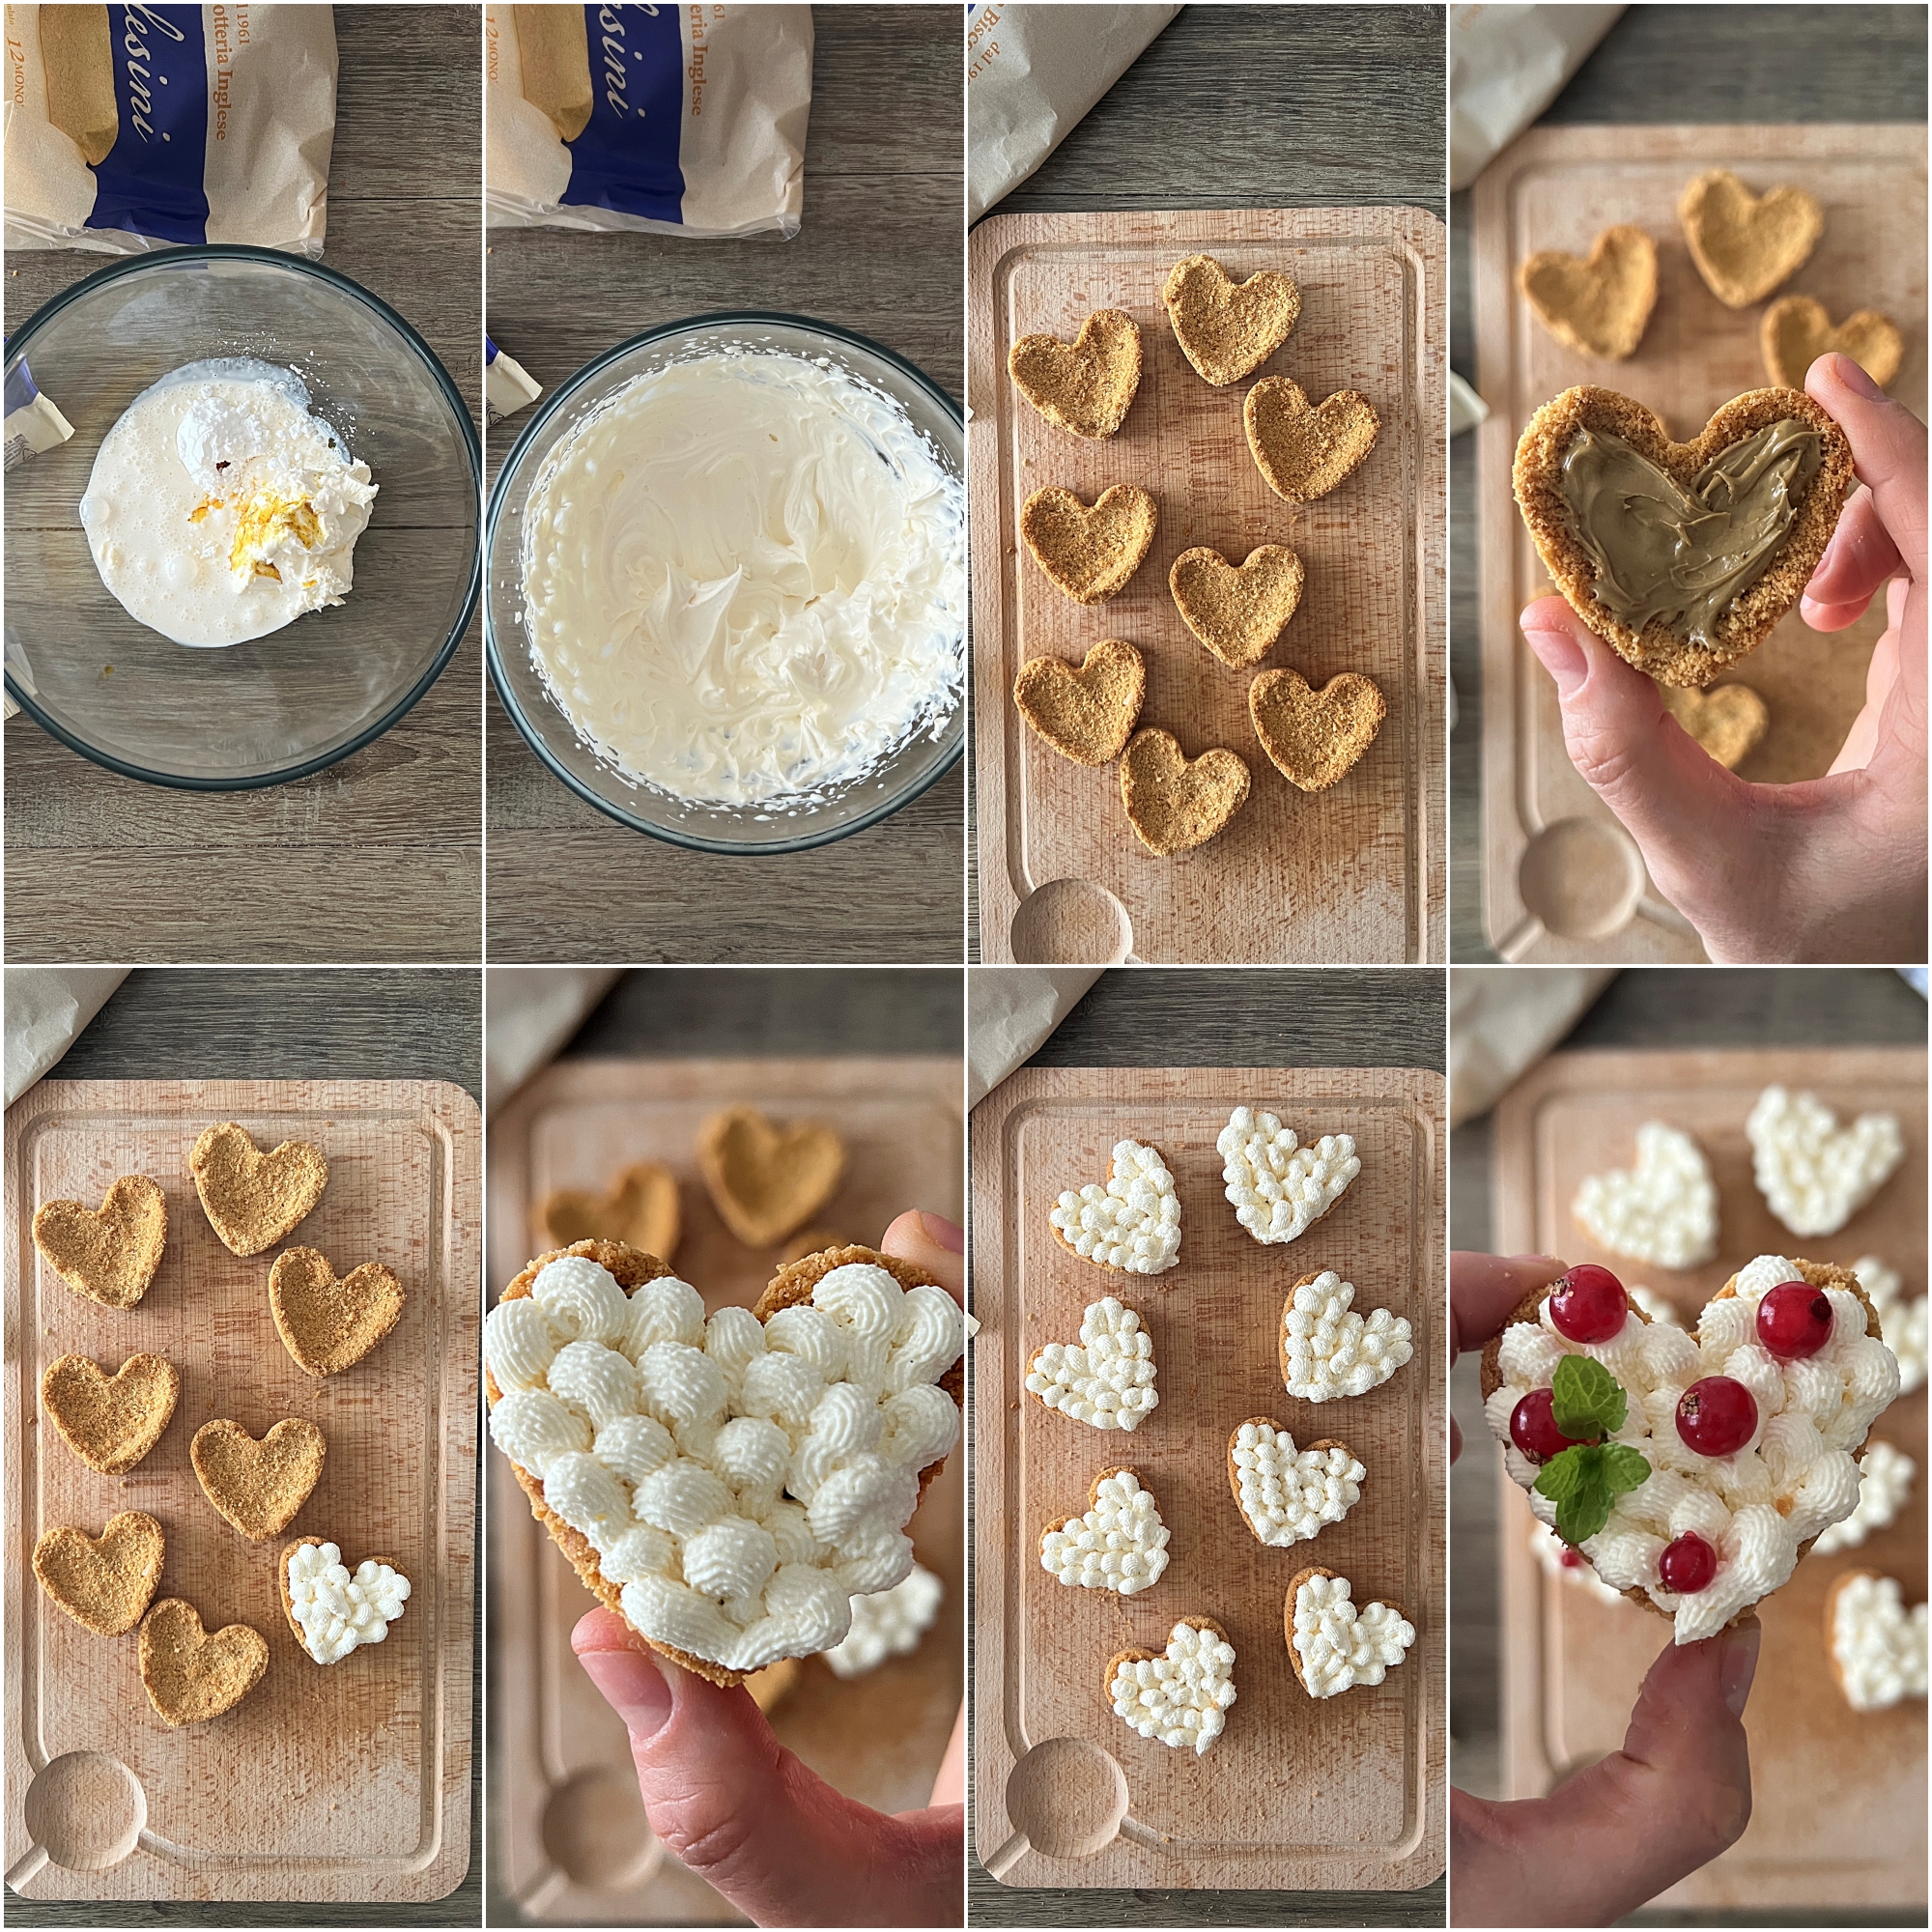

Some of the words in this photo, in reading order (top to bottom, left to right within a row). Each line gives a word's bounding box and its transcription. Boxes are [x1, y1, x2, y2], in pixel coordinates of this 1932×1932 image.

[237, 13, 251, 45] 1961
[980, 42, 1001, 66] dal
[213, 69, 234, 141] Inglese
[688, 44, 709, 117] Inglese
